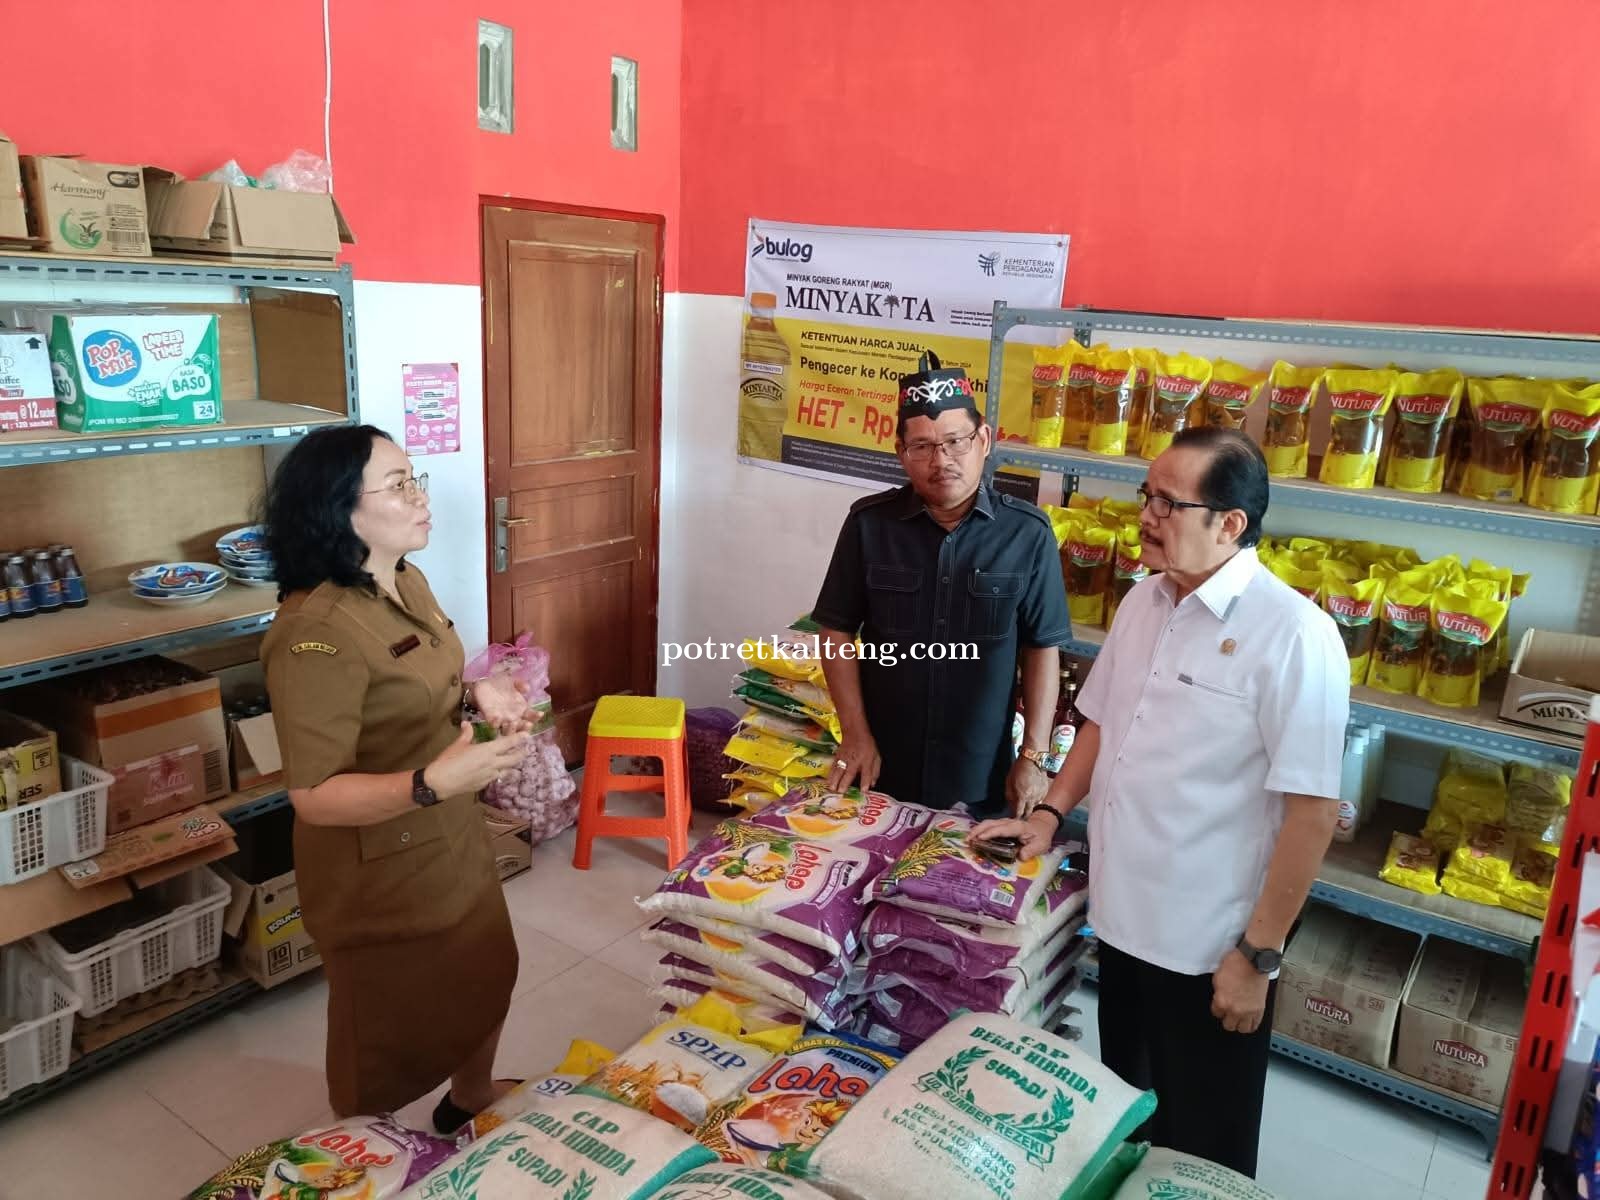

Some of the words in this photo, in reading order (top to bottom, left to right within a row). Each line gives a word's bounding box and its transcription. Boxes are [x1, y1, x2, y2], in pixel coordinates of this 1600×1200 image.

[766, 236, 813, 263] bulog
[1003, 264, 1055, 274] PERDAGANGAN
[1004, 258, 1055, 268] KEMENTERIAN
[787, 273, 811, 282] MINYAK
[812, 275, 841, 285] GORENG
[842, 278, 870, 288] RAKYAT
[870, 281, 892, 291] (MGR)
[87, 339, 121, 366] POP
[801, 331, 858, 346] KETENTUAN
[860, 338, 894, 350] HARGA
[896, 342, 925, 353] JUAL:
[800, 356, 857, 377] Pengecer
[861, 364, 876, 378] ke
[172, 375, 206, 393] BASO
[800, 379, 825, 393] Harga
[827, 383, 856, 396] Eceran
[856, 387, 897, 403] Tertinggi
[798, 396, 845, 430] HET
[1386, 606, 1429, 624] NUTUR
[1304, 998, 1351, 1025] NUTURA
[670, 1031, 746, 1070] SPHP
[1019, 1035, 1071, 1060] CAP
[1434, 1040, 1485, 1067] NUTURA
[826, 1048, 881, 1074] PREMIUM
[969, 1026, 1025, 1056] BERAS
[1022, 1050, 1098, 1104] HIBRIDA
[984, 1058, 1048, 1100] SUPADI
[572, 1111, 620, 1135] CAP
[941, 1090, 994, 1127] SUMBER
[994, 1121, 1045, 1156] REZEKI
[519, 1112, 568, 1139] BERAS
[561, 1128, 637, 1177] HIBRIDA
[507, 1146, 568, 1188] SUPADI
